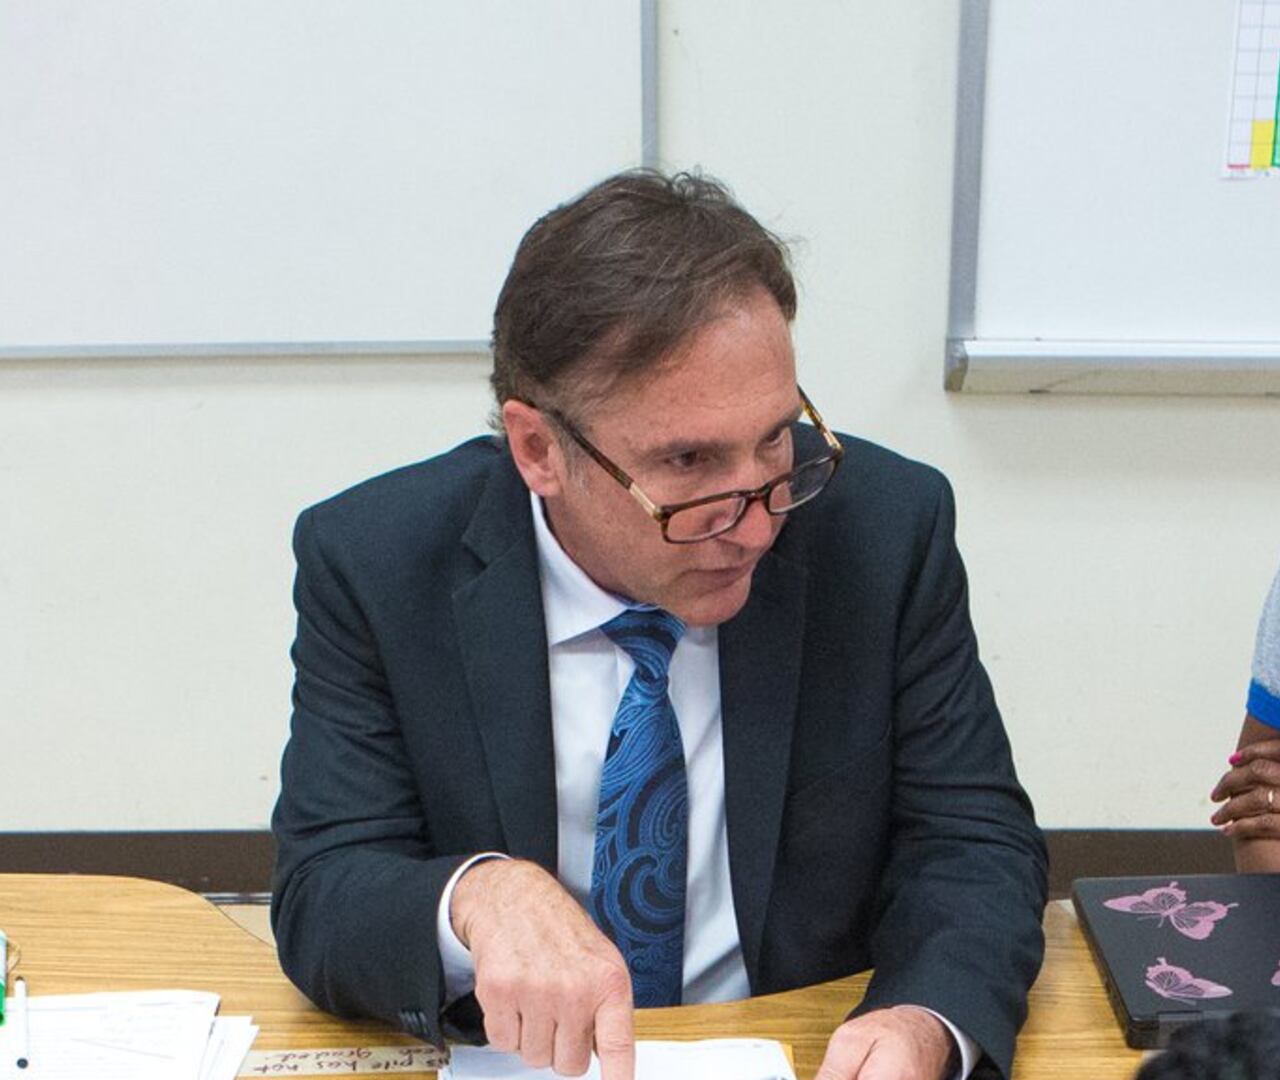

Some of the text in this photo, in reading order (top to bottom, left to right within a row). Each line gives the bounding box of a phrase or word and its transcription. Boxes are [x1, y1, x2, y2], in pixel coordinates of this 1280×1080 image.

[252, 1063, 298, 1074] not
[316, 1060, 357, 1072] has
[370, 1054, 414, 1072] pile
